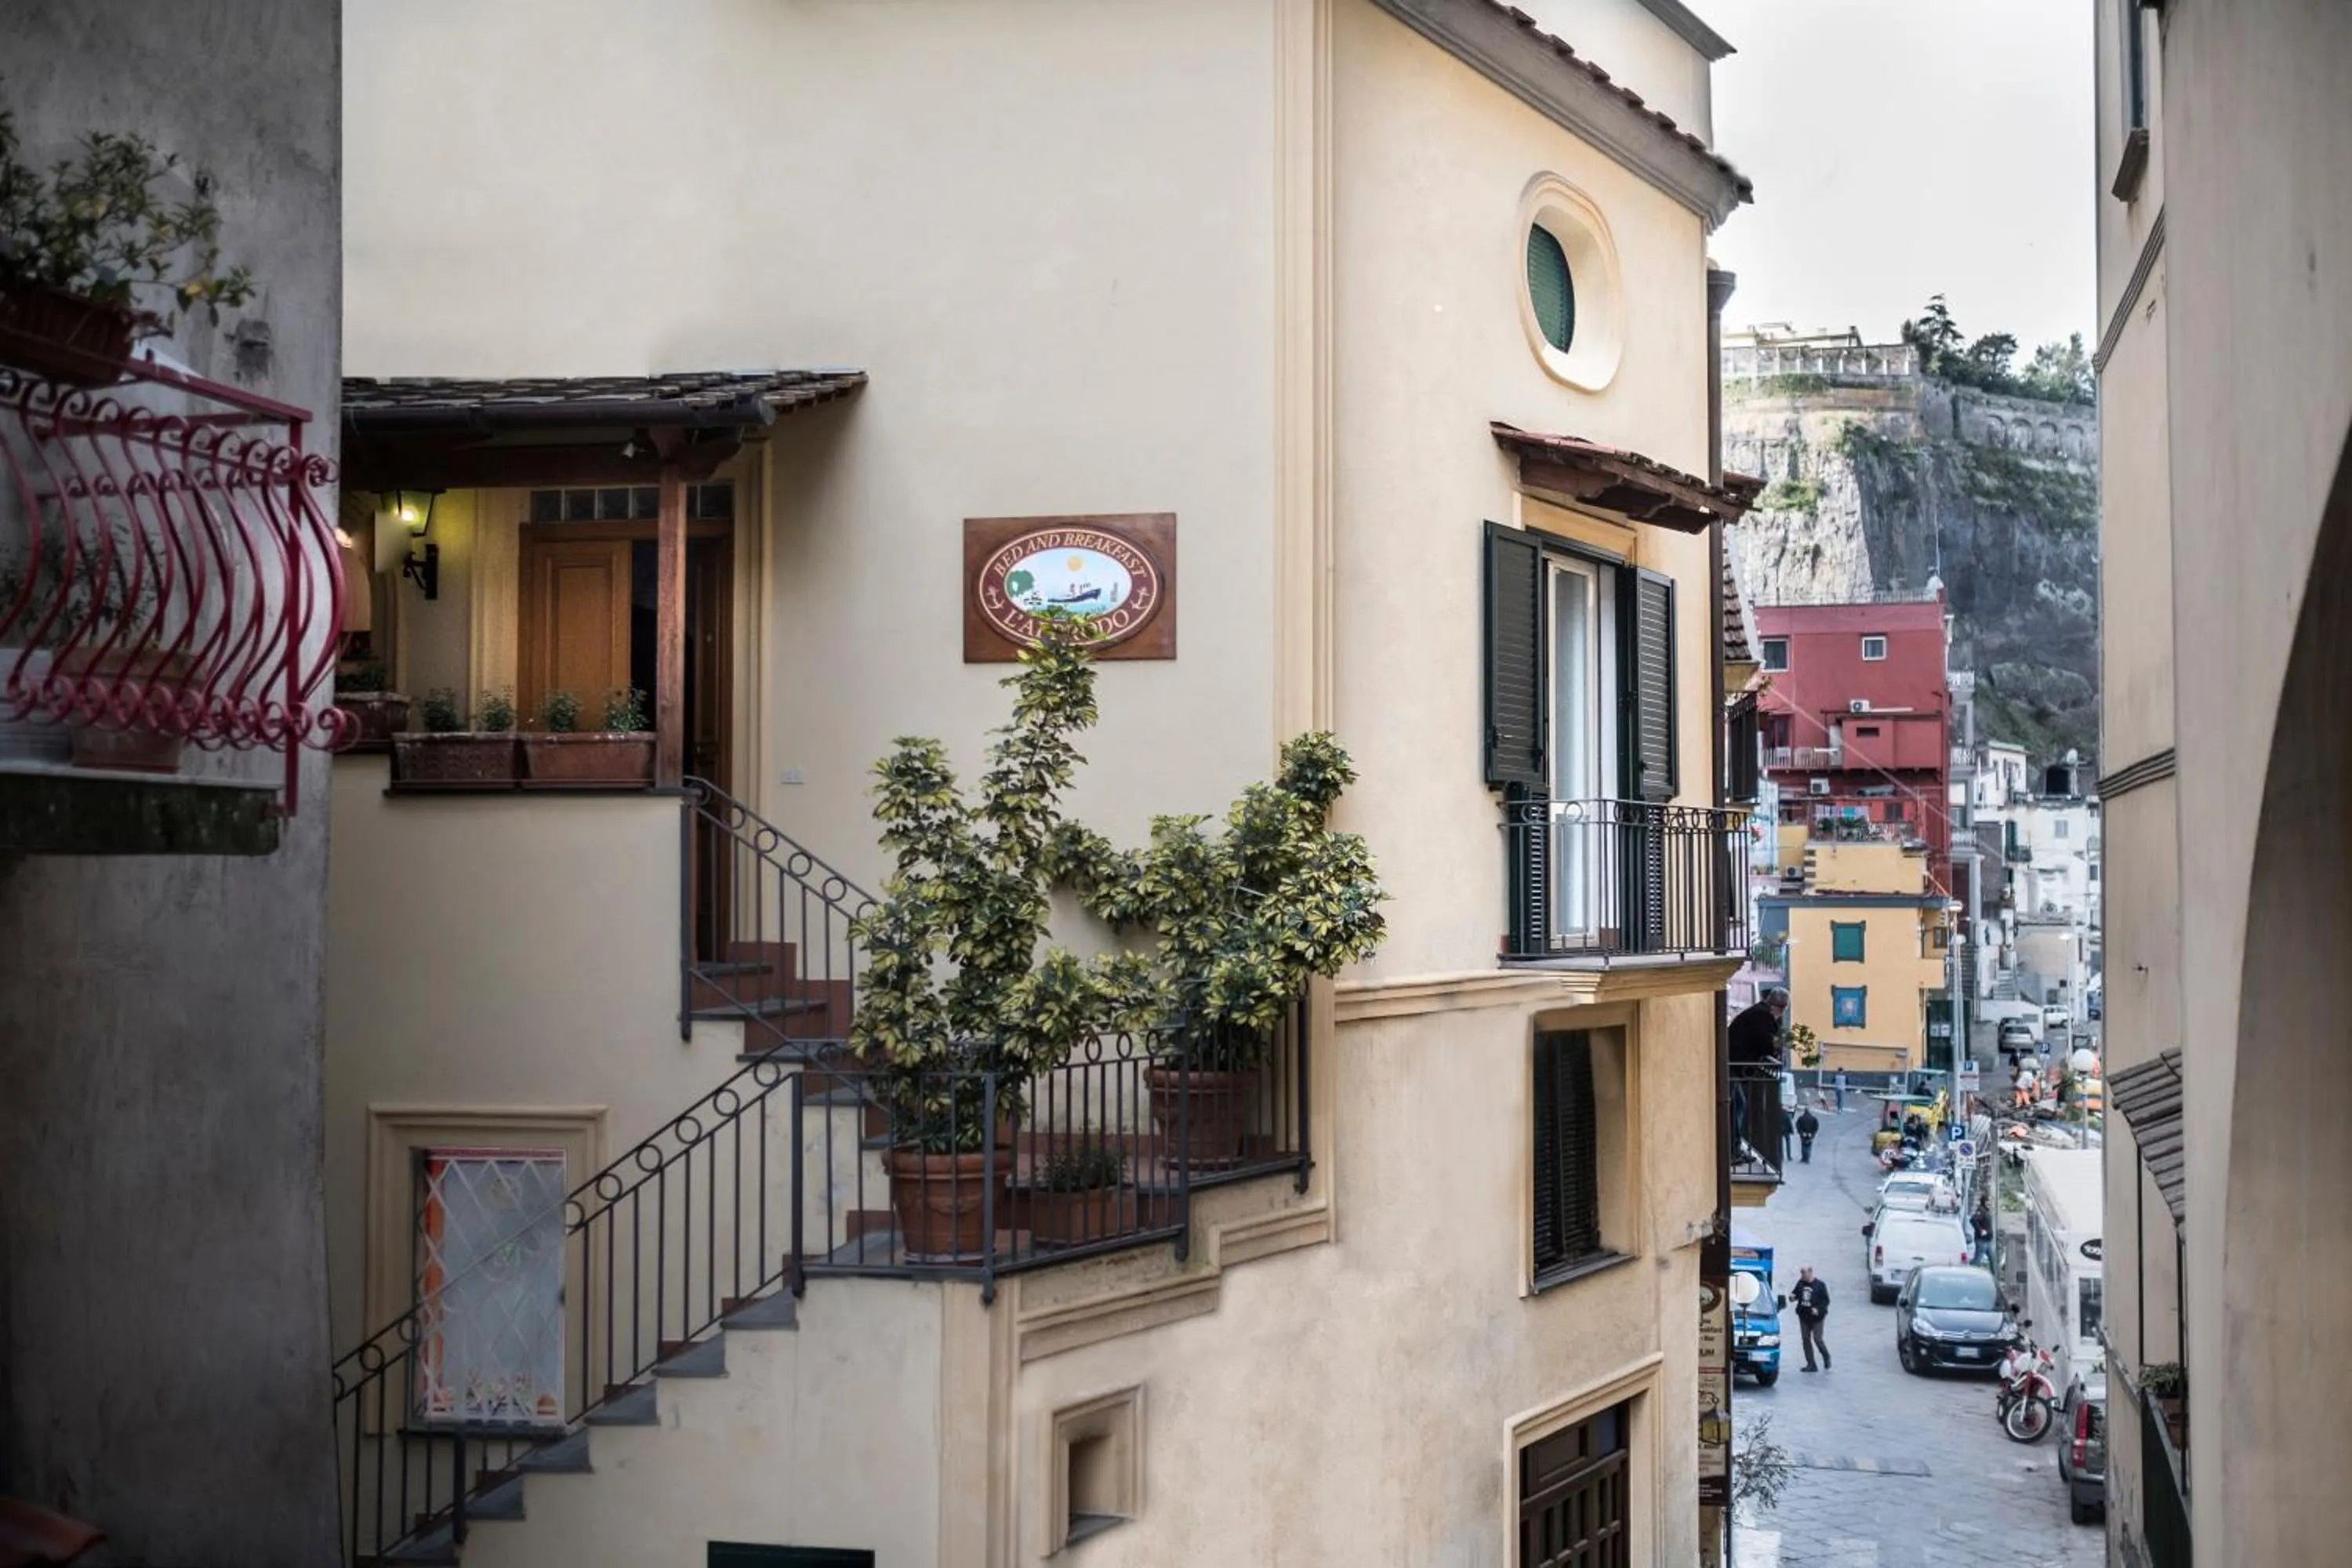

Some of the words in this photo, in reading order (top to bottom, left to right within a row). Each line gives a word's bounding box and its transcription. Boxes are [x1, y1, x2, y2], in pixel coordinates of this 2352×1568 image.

[993, 546, 1023, 578] BED
[1025, 535, 1060, 555] AND
[1064, 533, 1147, 579] BREAKFAST
[1951, 1127, 1962, 1139] P
